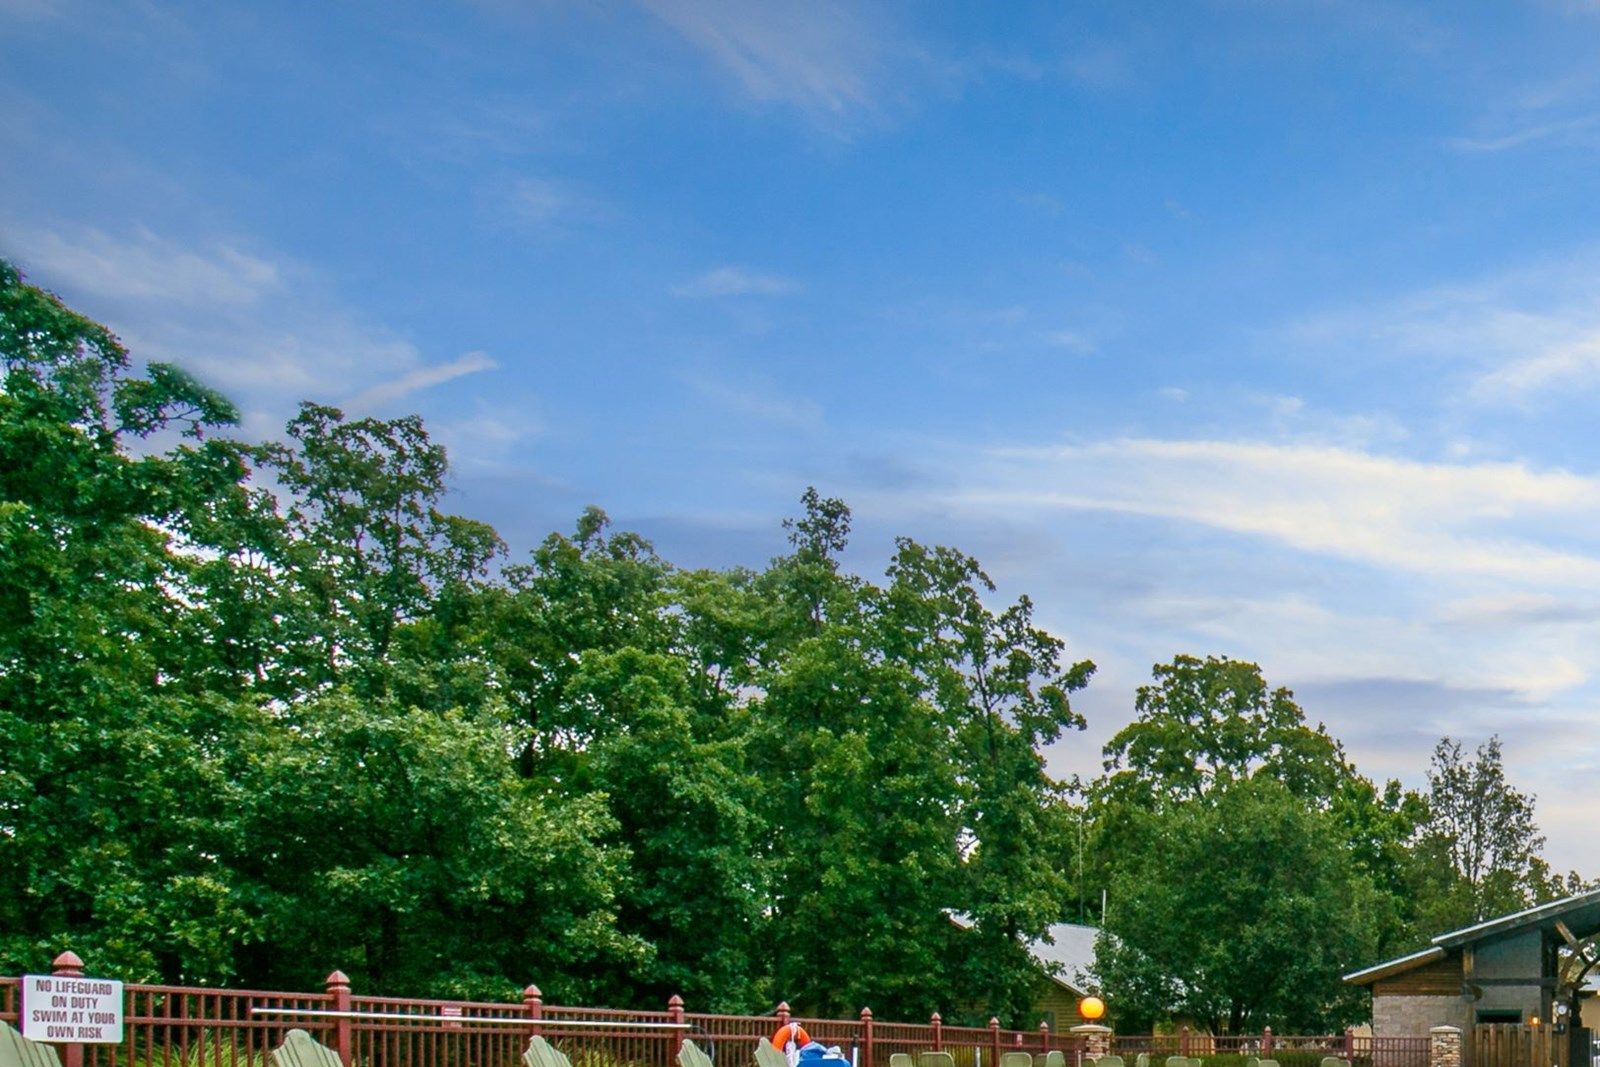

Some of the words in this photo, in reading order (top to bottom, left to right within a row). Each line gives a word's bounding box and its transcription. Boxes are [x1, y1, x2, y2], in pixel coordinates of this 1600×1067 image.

[36, 980, 52, 992] NO
[56, 980, 112, 995] LIFEGUARD
[51, 995, 67, 1008] ON
[71, 996, 98, 1009] DUTY
[33, 1010, 67, 1022] SWIM
[71, 1012, 84, 1023] AT
[88, 1012, 115, 1025] YOUR
[47, 1025, 74, 1038] OWN
[78, 1026, 102, 1039] RISK
